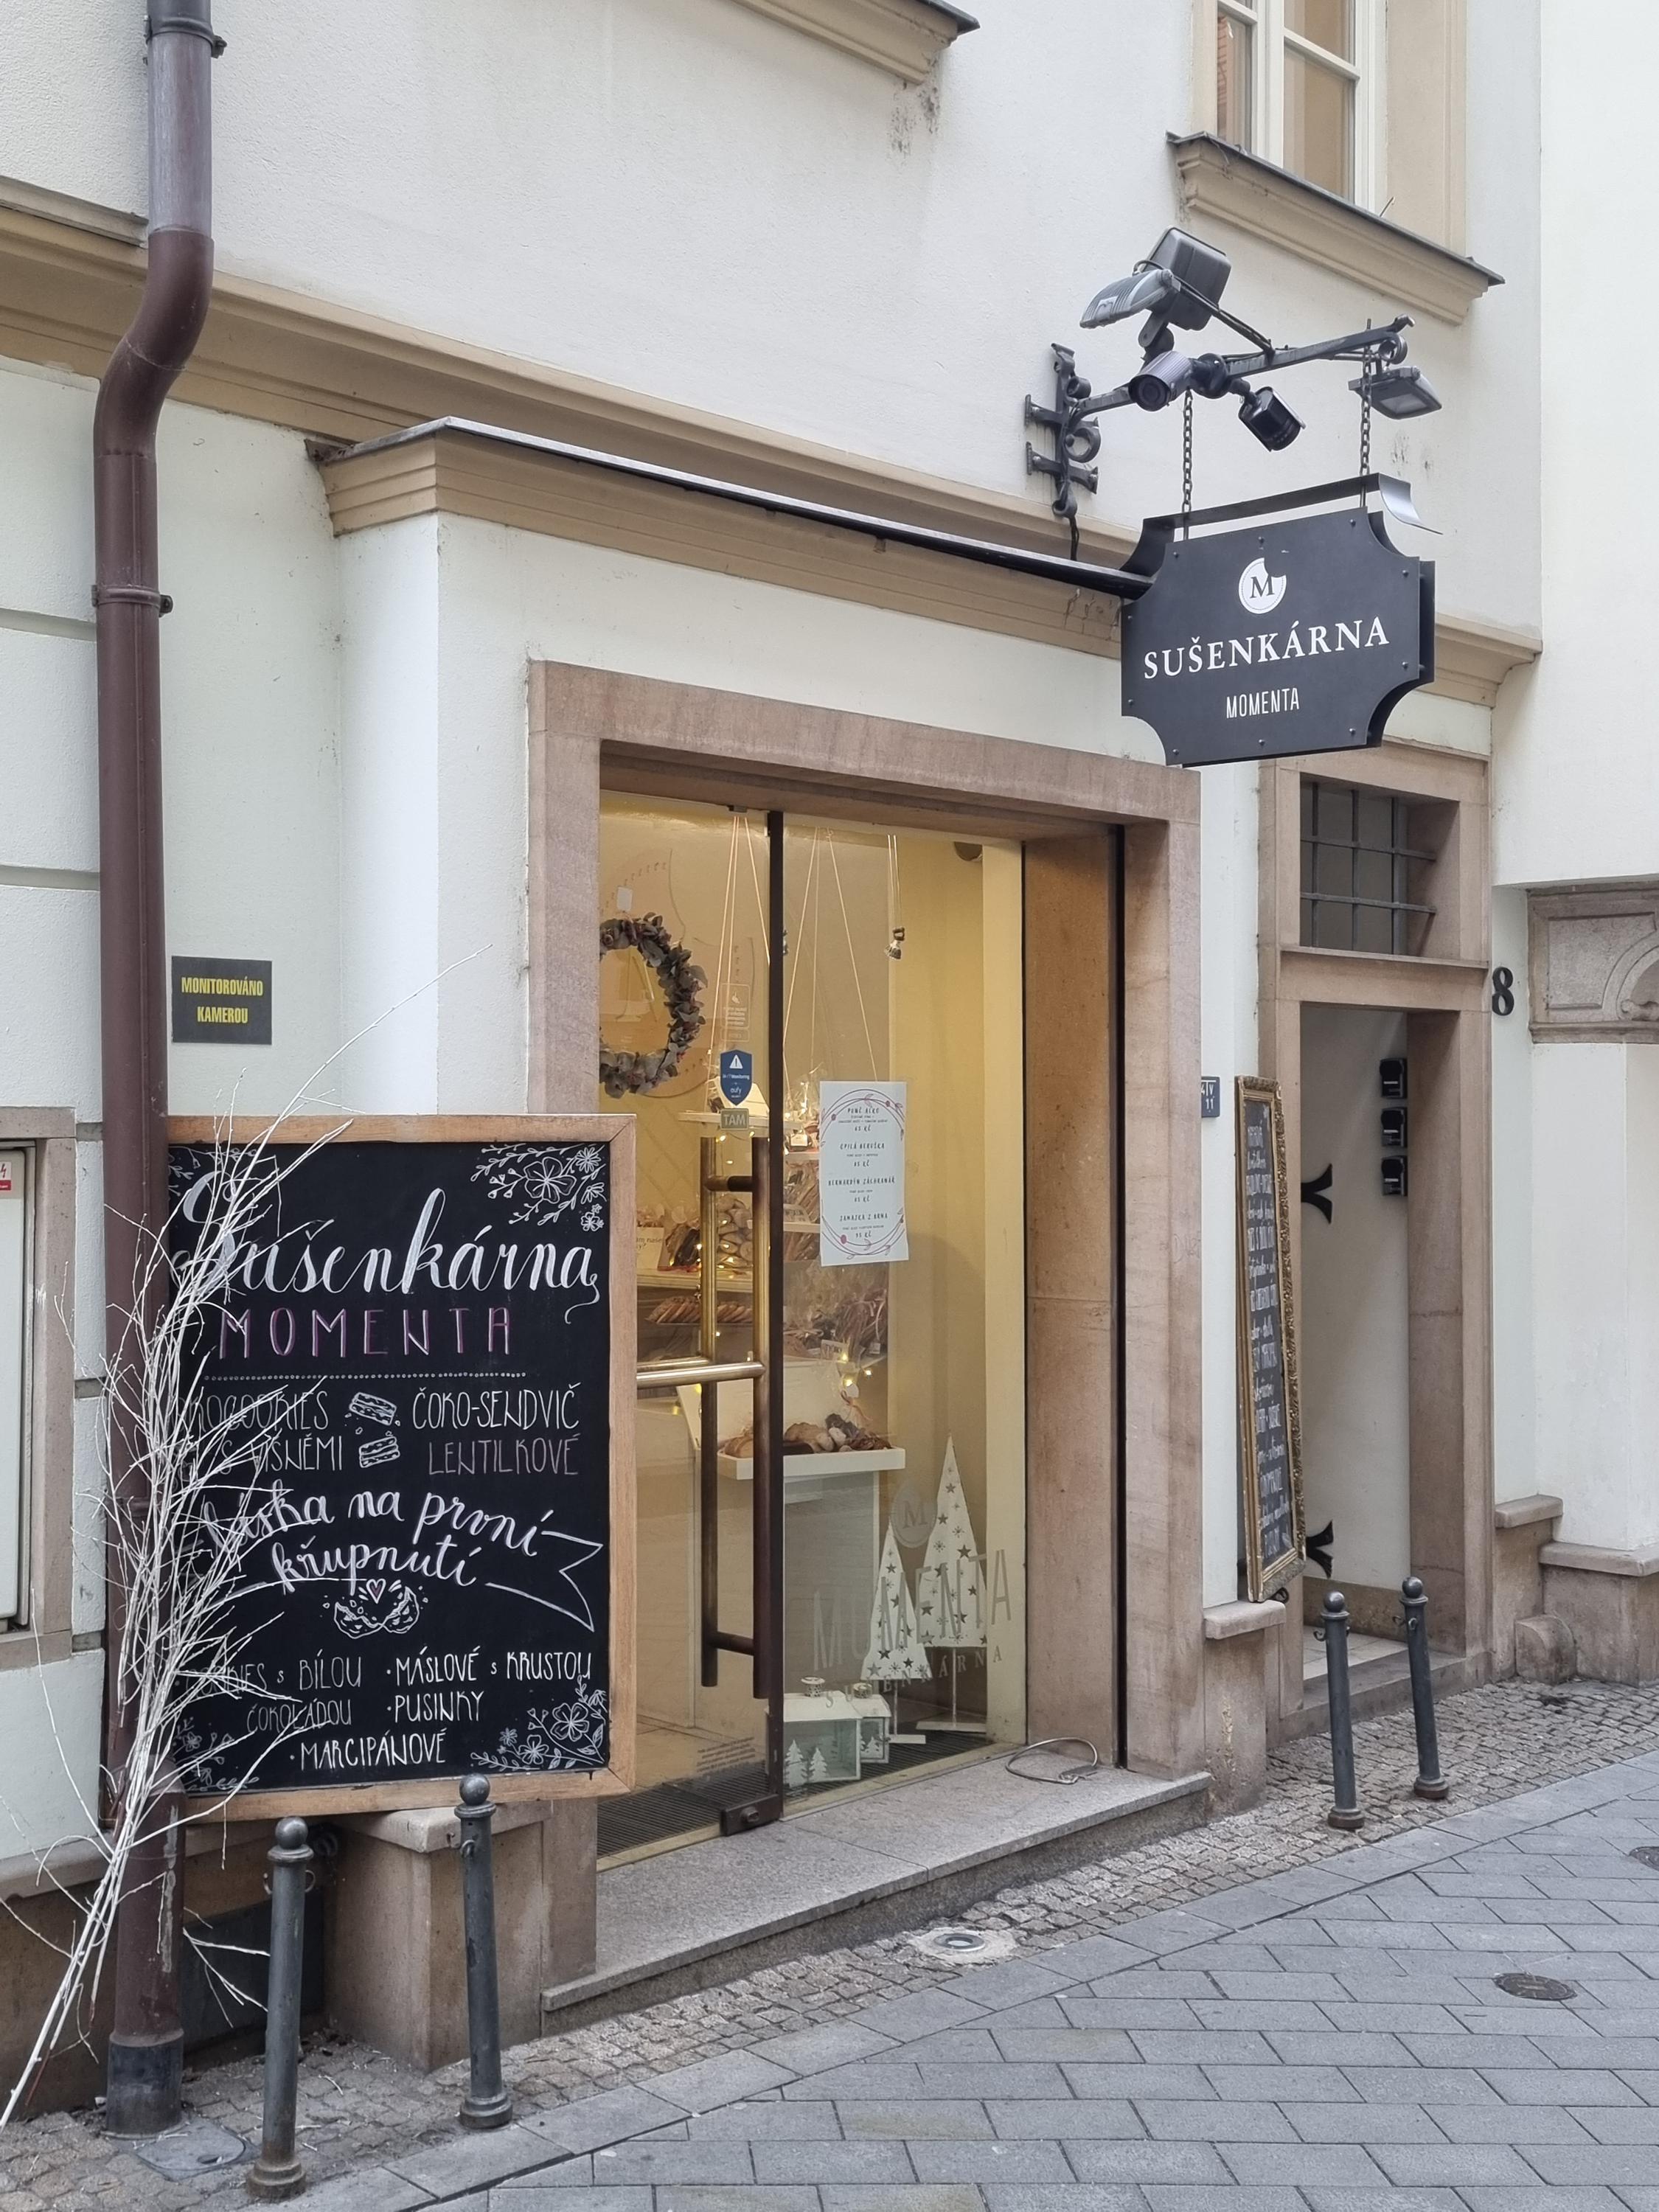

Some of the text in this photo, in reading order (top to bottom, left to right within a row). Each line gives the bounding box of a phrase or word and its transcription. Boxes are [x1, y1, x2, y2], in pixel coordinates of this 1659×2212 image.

[1144, 616, 1390, 679] SUŠENKÁRNA
[1225, 687, 1299, 719] MOMENTA
[181, 975, 263, 996] MONITOROVÁNO
[1492, 967, 1514, 1016] 8
[197, 1006, 248, 1023] KAMEROU
[723, 1113, 746, 1126] TAM
[220, 1307, 510, 1360] MOMENTA
[413, 1382, 581, 1430] ČOKO-SENDVIČ
[429, 1433, 581, 1475] LENTILKOVÉ
[348, 1489, 405, 1523] na
[413, 1491, 554, 1557] první
[271, 1534, 483, 1596] křupnutí
[299, 1649, 361, 1690] BÍLOU
[396, 1646, 481, 1686] MÁSLOVÉ
[507, 1652, 591, 1681] KRUSTOU
[247, 1697, 352, 1733] ČOKOLÁDOU
[394, 1691, 484, 1723] PUSINKY
[301, 1728, 448, 1770] MARCIPÁNOVÉ
